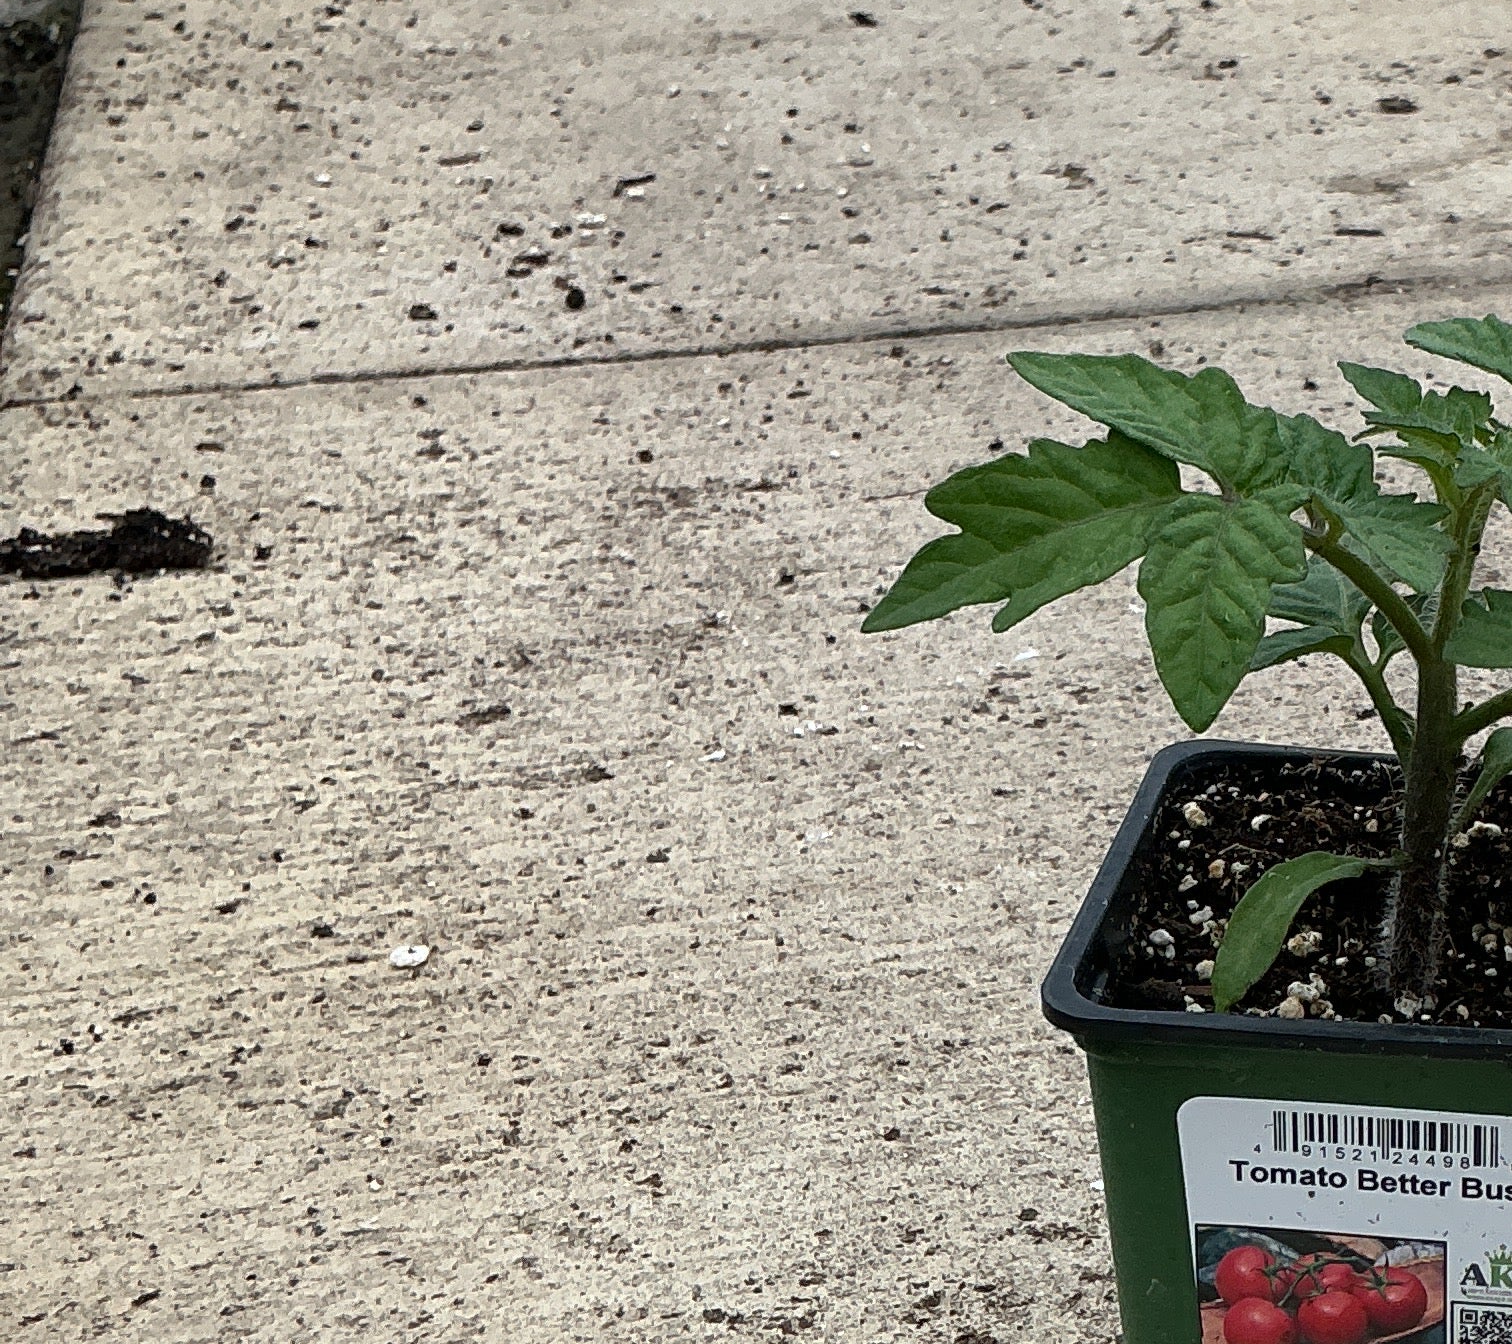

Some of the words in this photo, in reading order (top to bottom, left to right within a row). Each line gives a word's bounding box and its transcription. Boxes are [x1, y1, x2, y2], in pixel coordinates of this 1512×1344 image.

[1253, 1143, 1262, 1154] 4
[1301, 1144, 1377, 1163] 91521
[1392, 1151, 1471, 1170] 24498
[1228, 1159, 1348, 1189] Tomato
[1357, 1168, 1452, 1197] Better
